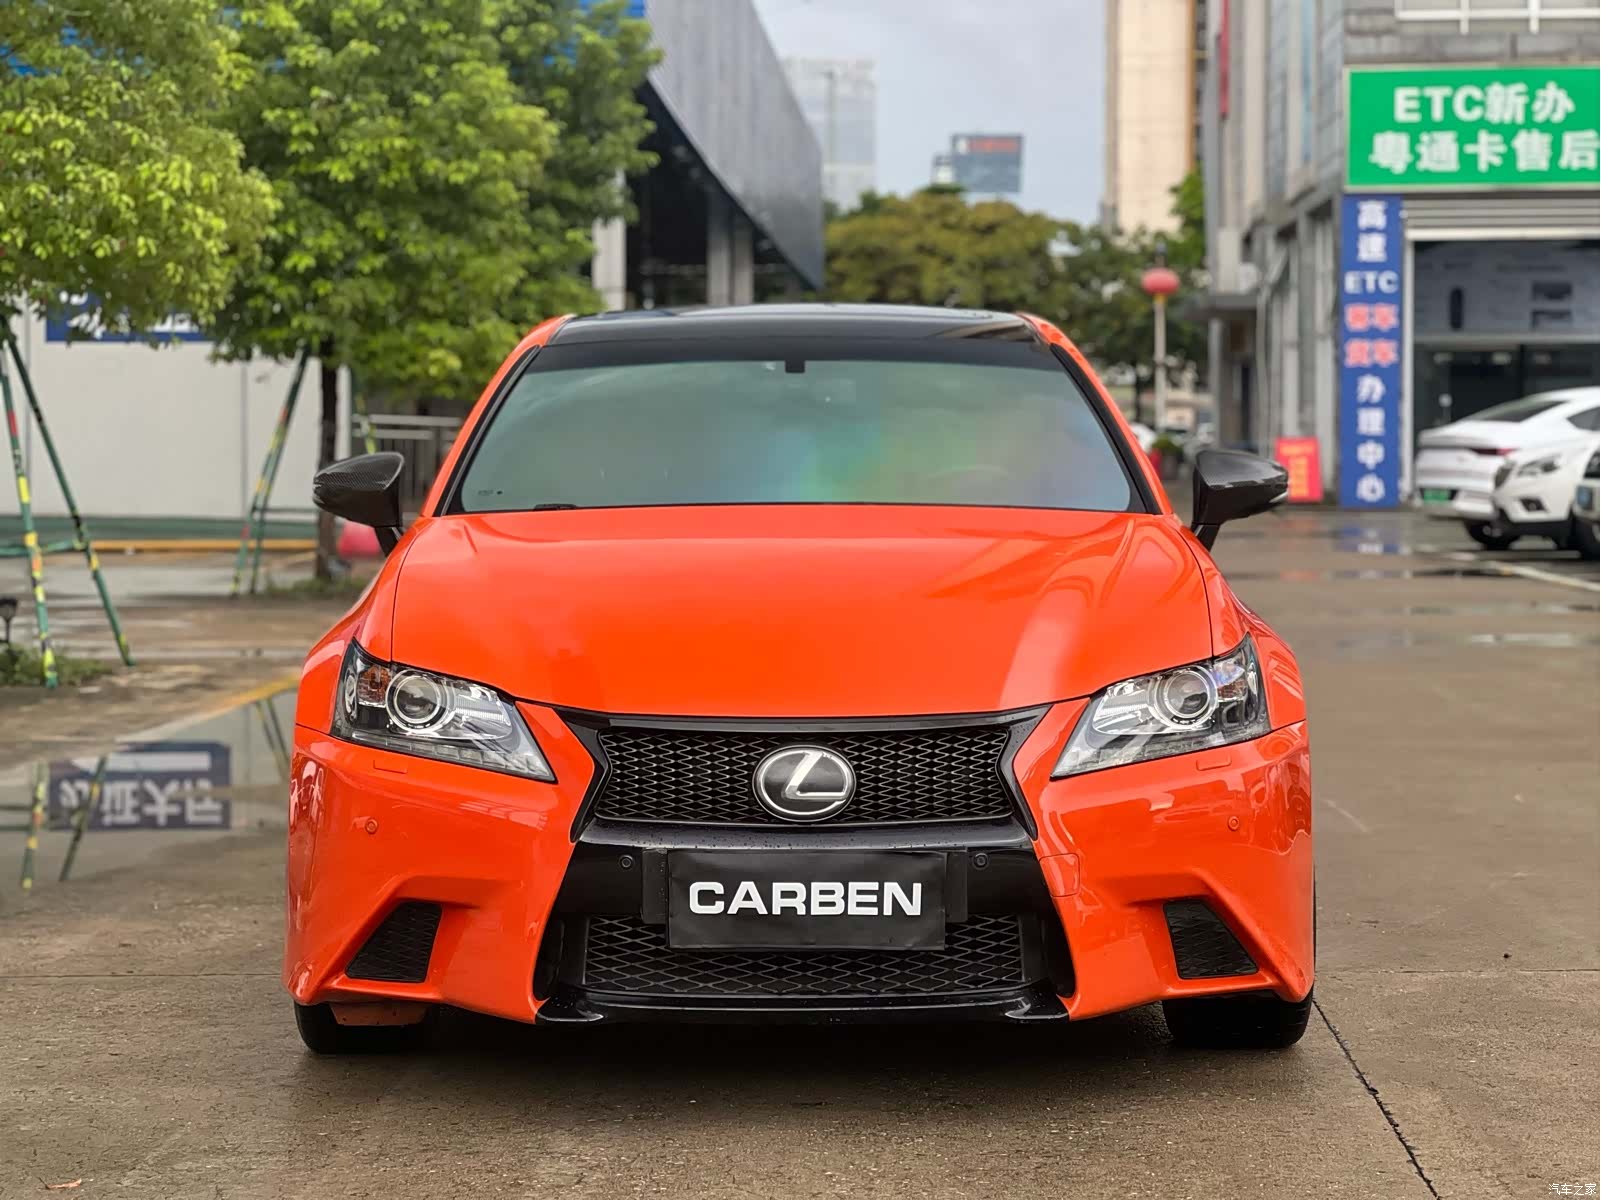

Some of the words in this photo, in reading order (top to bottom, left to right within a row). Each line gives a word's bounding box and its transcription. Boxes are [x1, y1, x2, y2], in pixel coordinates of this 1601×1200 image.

[1393, 81, 1576, 124] ETC新办
[1368, 128, 1600, 175] 粤通卡售后
[1344, 271, 1397, 294] ETC
[1357, 374, 1386, 502] 办理中心
[689, 881, 922, 916] CARBEN
